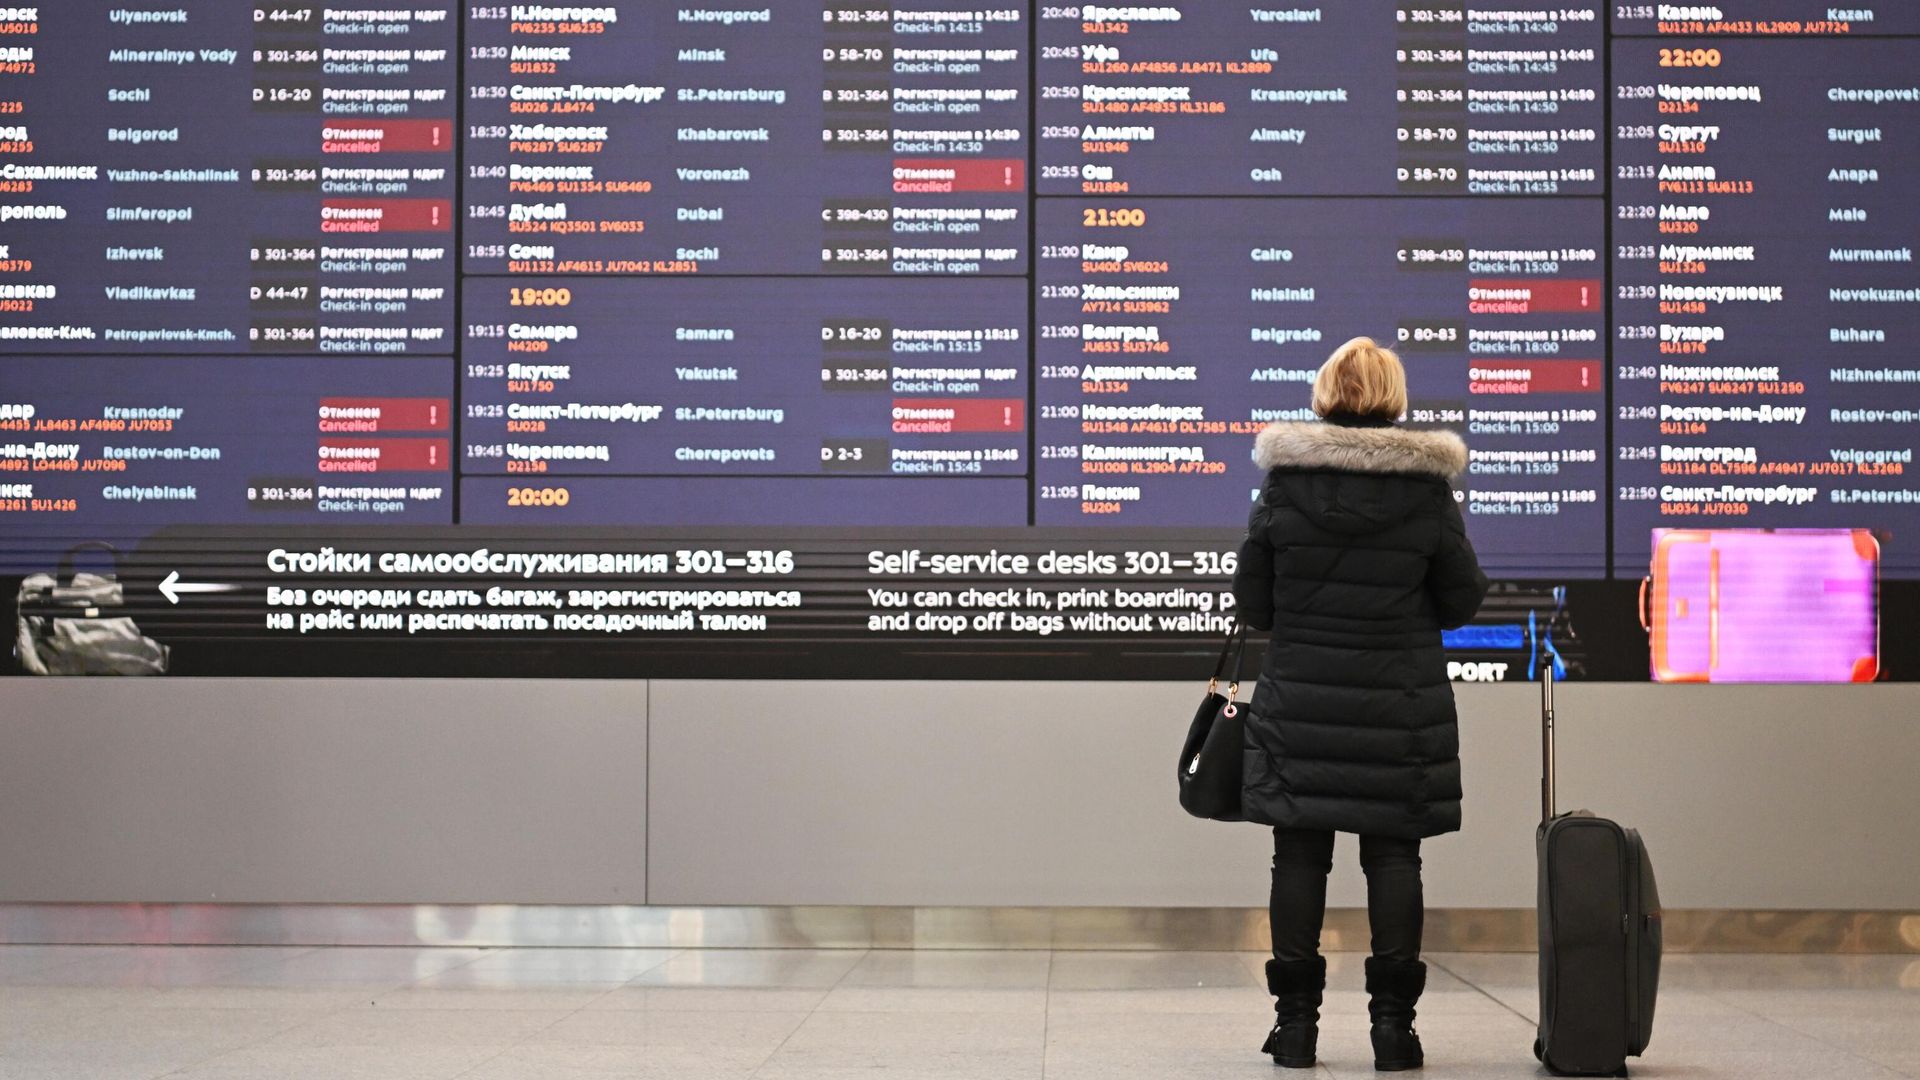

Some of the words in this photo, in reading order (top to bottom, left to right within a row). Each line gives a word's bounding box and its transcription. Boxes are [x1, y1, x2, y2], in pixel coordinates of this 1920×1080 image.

[109, 9, 188, 24] Ulyanovsk
[253, 10, 266, 21] D
[269, 10, 312, 21] 44-47
[471, 7, 508, 19] 18:15
[678, 9, 771, 24] N.Novgorod
[1042, 7, 1080, 18] 20:40
[1250, 9, 1321, 21] Yaroslavl
[1657, 5, 1723, 20] Казань
[1827, 9, 1874, 21] Kazan
[323, 21, 375, 33] Check-in
[377, 24, 410, 35] open
[893, 21, 946, 32] Check-in
[949, 21, 983, 32] 14:15
[1467, 20, 1521, 32] Check-in
[1523, 20, 1558, 33] 14:40
[199, 49, 238, 64] Vody
[252, 51, 263, 61] B
[267, 51, 318, 62] 301-364
[470, 47, 508, 58] 18:30
[510, 46, 571, 60] Минск
[677, 49, 726, 61] Minsk
[822, 49, 836, 60] D
[839, 49, 883, 60] 58-70
[1081, 44, 1120, 64] Уфа
[1250, 49, 1279, 61] Ufa
[1659, 49, 1722, 66] 22:00
[108, 88, 150, 101] Sochi
[677, 89, 786, 103] St.Petersburg
[1041, 87, 1080, 98] 20:50
[1250, 88, 1348, 103] Krasnoyarsk
[1396, 90, 1407, 101] B
[1411, 90, 1463, 101] 301-364
[1617, 86, 1656, 98] 22:00
[107, 128, 179, 143] Belgorod
[321, 128, 384, 139] Отменен
[677, 128, 769, 140] Khabarovsk
[1250, 128, 1306, 143] Almaty
[1827, 128, 1882, 143] Surgut
[322, 141, 380, 154] Cancelled
[469, 166, 507, 177] 18:40
[676, 168, 750, 180] Voronezh
[1081, 164, 1113, 180] Ош
[1250, 168, 1282, 181] Osh
[1657, 165, 1716, 180] Анапа
[1827, 169, 1879, 183] Anapa
[893, 181, 952, 193] Cancelled
[106, 207, 193, 222] Simferopol
[508, 203, 567, 223] Дубай
[676, 208, 723, 220] Dubai
[1083, 209, 1146, 226] 21:00
[1658, 204, 1710, 220] Мале
[1828, 208, 1867, 221] Male
[106, 247, 164, 260] Izhevsk
[508, 244, 555, 259] Сочи
[676, 248, 719, 260] Sochi
[1041, 246, 1080, 258] 21:00
[1082, 244, 1130, 265] Каир
[1250, 248, 1293, 261] Cairo
[1396, 250, 1407, 261] C
[1412, 250, 1465, 261] 398-430
[1828, 248, 1912, 261] Murmansk
[105, 287, 196, 300] Vladikavkaz
[510, 288, 571, 305] 19:00
[1250, 288, 1315, 301] Helsinki
[1468, 288, 1532, 300] Отменен
[1469, 302, 1529, 313] Cancelled
[507, 324, 578, 344] Самара
[675, 328, 734, 340] Samara
[1082, 324, 1160, 343] Белград
[1250, 328, 1322, 344] Belgrade
[1397, 328, 1410, 341] D
[1413, 328, 1457, 341] 80-83
[1829, 328, 1885, 341] Buhara
[1468, 340, 1522, 353] Check-in
[1525, 340, 1560, 353] 18:00
[507, 363, 571, 383] Якутск
[675, 367, 738, 380] Yakutsk
[103, 406, 184, 421] Krasnodar
[1412, 410, 1464, 422] 301-364
[103, 447, 221, 461] Rostov-on-Don
[467, 445, 504, 457] 19:45
[674, 448, 776, 462] Cherepovets
[820, 448, 834, 460] D
[837, 448, 863, 460] 2-3
[102, 486, 197, 501] Chelyabinsk
[507, 488, 570, 506] 20:00
[1041, 486, 1079, 498] 21:05
[1081, 485, 1141, 500] Пекин
[1469, 502, 1522, 514] Check-in
[1525, 501, 1559, 514] 15:05
[266, 547, 372, 572] Стойки
[378, 549, 669, 578] самообслуживания
[867, 550, 1030, 574] Self-service
[1036, 550, 1118, 574] desks
[266, 587, 308, 605] Без
[311, 590, 412, 611] очереди
[416, 590, 482, 608] сдать
[485, 587, 564, 609] багаж,
[567, 591, 802, 612] зарегистрироваться
[866, 588, 906, 607] You
[912, 592, 953, 607] can
[957, 588, 1021, 607] check
[1025, 588, 1052, 609] in,
[1057, 588, 1109, 613] print
[1114, 588, 1214, 614] boarding
[266, 613, 295, 629] на
[299, 609, 355, 633] рейс
[359, 614, 403, 629] или
[408, 614, 549, 633] распечатать
[553, 609, 695, 632] посадочный
[698, 615, 767, 630] талон
[867, 612, 911, 630] and
[915, 612, 968, 634] drop
[972, 612, 1006, 631] off
[1010, 610, 1065, 635] bags
[1069, 612, 1154, 631] without
[1446, 661, 1509, 683] PORT
